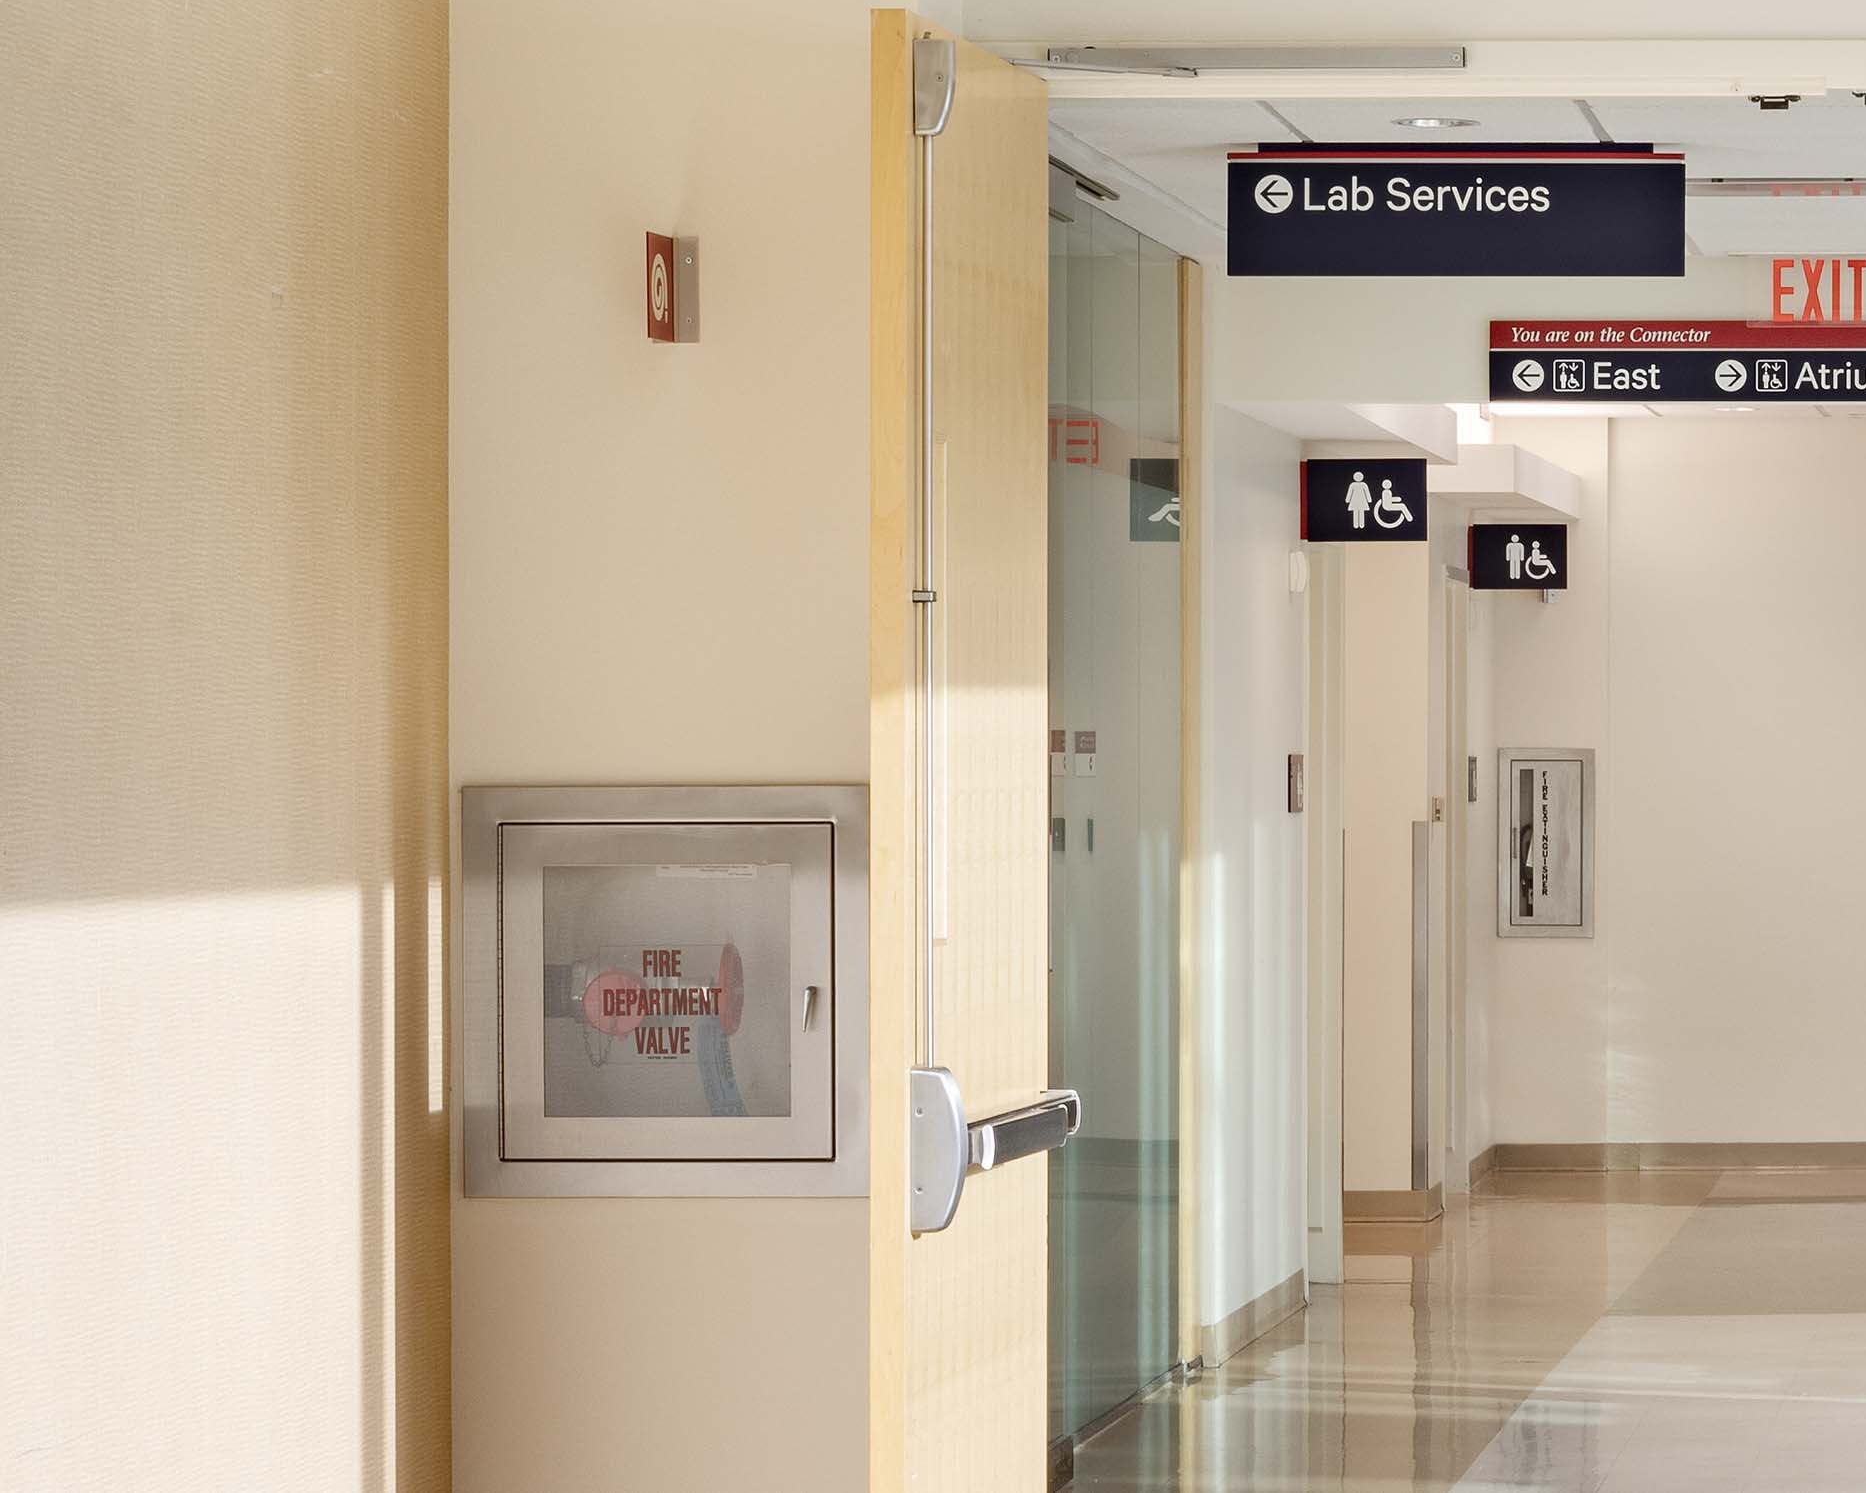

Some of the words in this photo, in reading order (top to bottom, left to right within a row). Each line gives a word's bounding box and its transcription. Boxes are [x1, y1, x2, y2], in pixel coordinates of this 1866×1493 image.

[1303, 176, 1374, 212] Lab
[1386, 177, 1550, 212] Services
[1511, 327, 1541, 343] You
[1545, 330, 1570, 343] are
[1574, 330, 1595, 343] on
[1600, 326, 1626, 343] the
[1630, 326, 1712, 343] Connector
[1593, 361, 1661, 390] East
[642, 949, 682, 978] FIRE
[603, 988, 722, 1017] DEPARTMENT
[634, 1026, 691, 1055] VALVE
